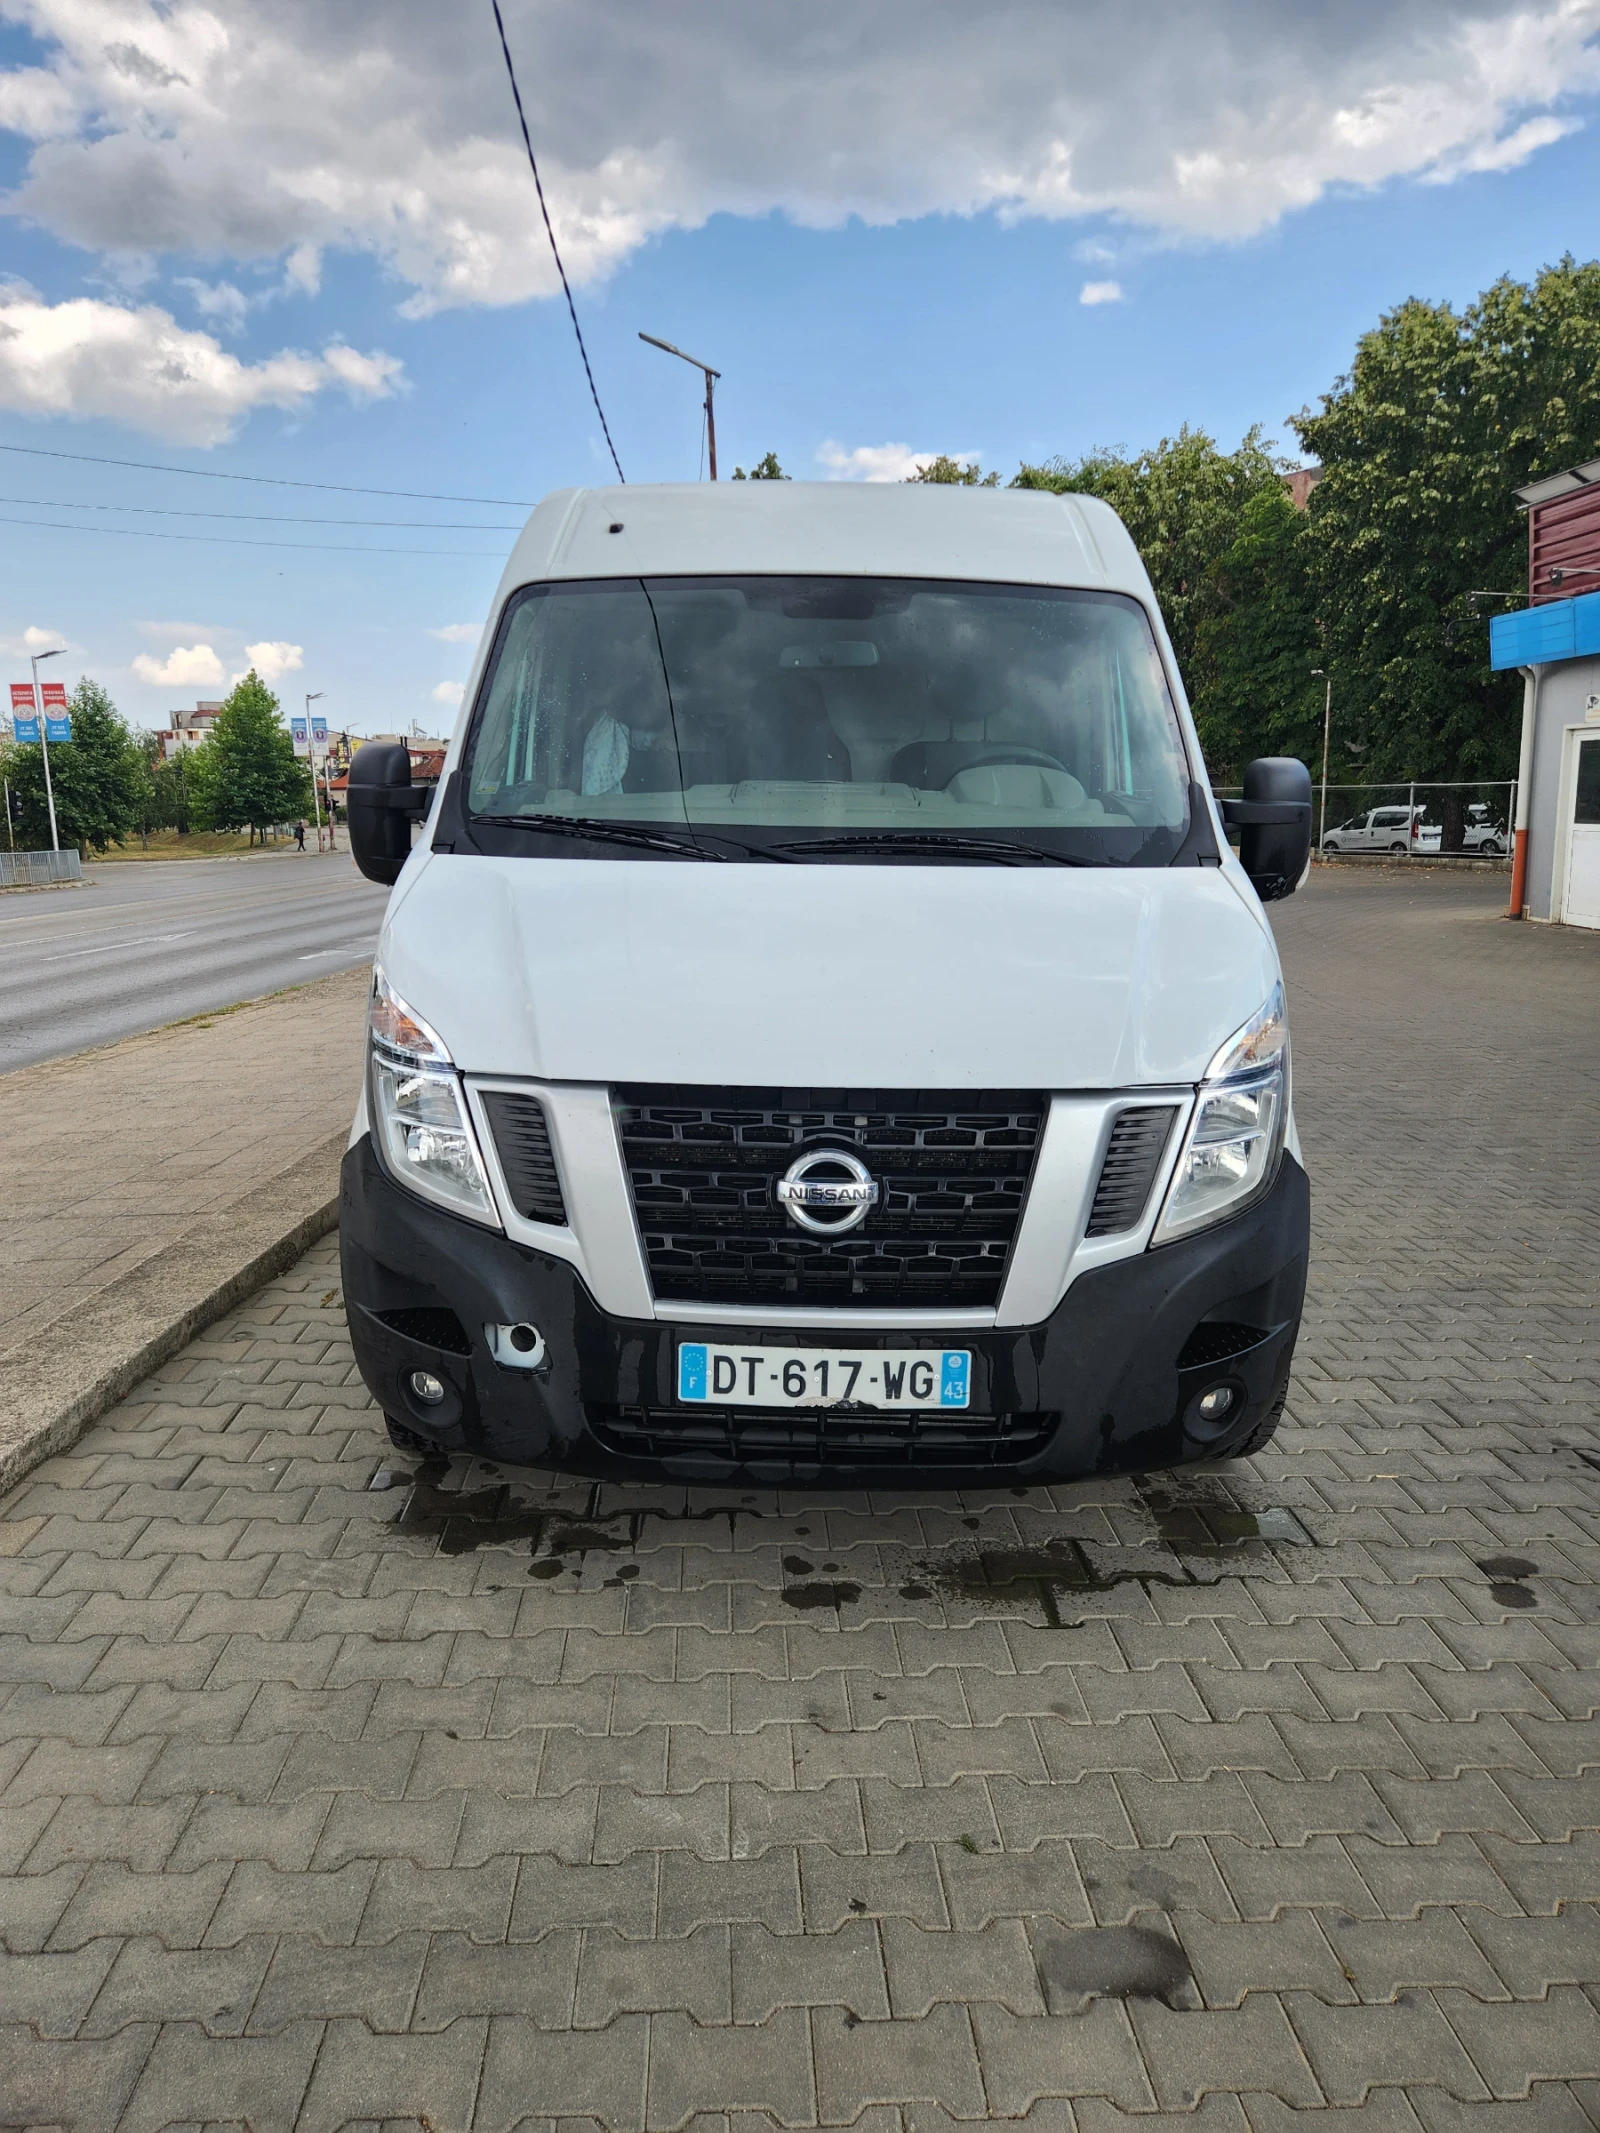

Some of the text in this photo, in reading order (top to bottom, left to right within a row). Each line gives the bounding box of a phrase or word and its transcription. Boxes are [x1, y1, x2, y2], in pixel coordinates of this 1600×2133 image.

[788, 1187, 867, 1201] NISSAN
[689, 1376, 698, 1389] F
[713, 1355, 934, 1400] DT-617-WG
[944, 1381, 964, 1399] 43
